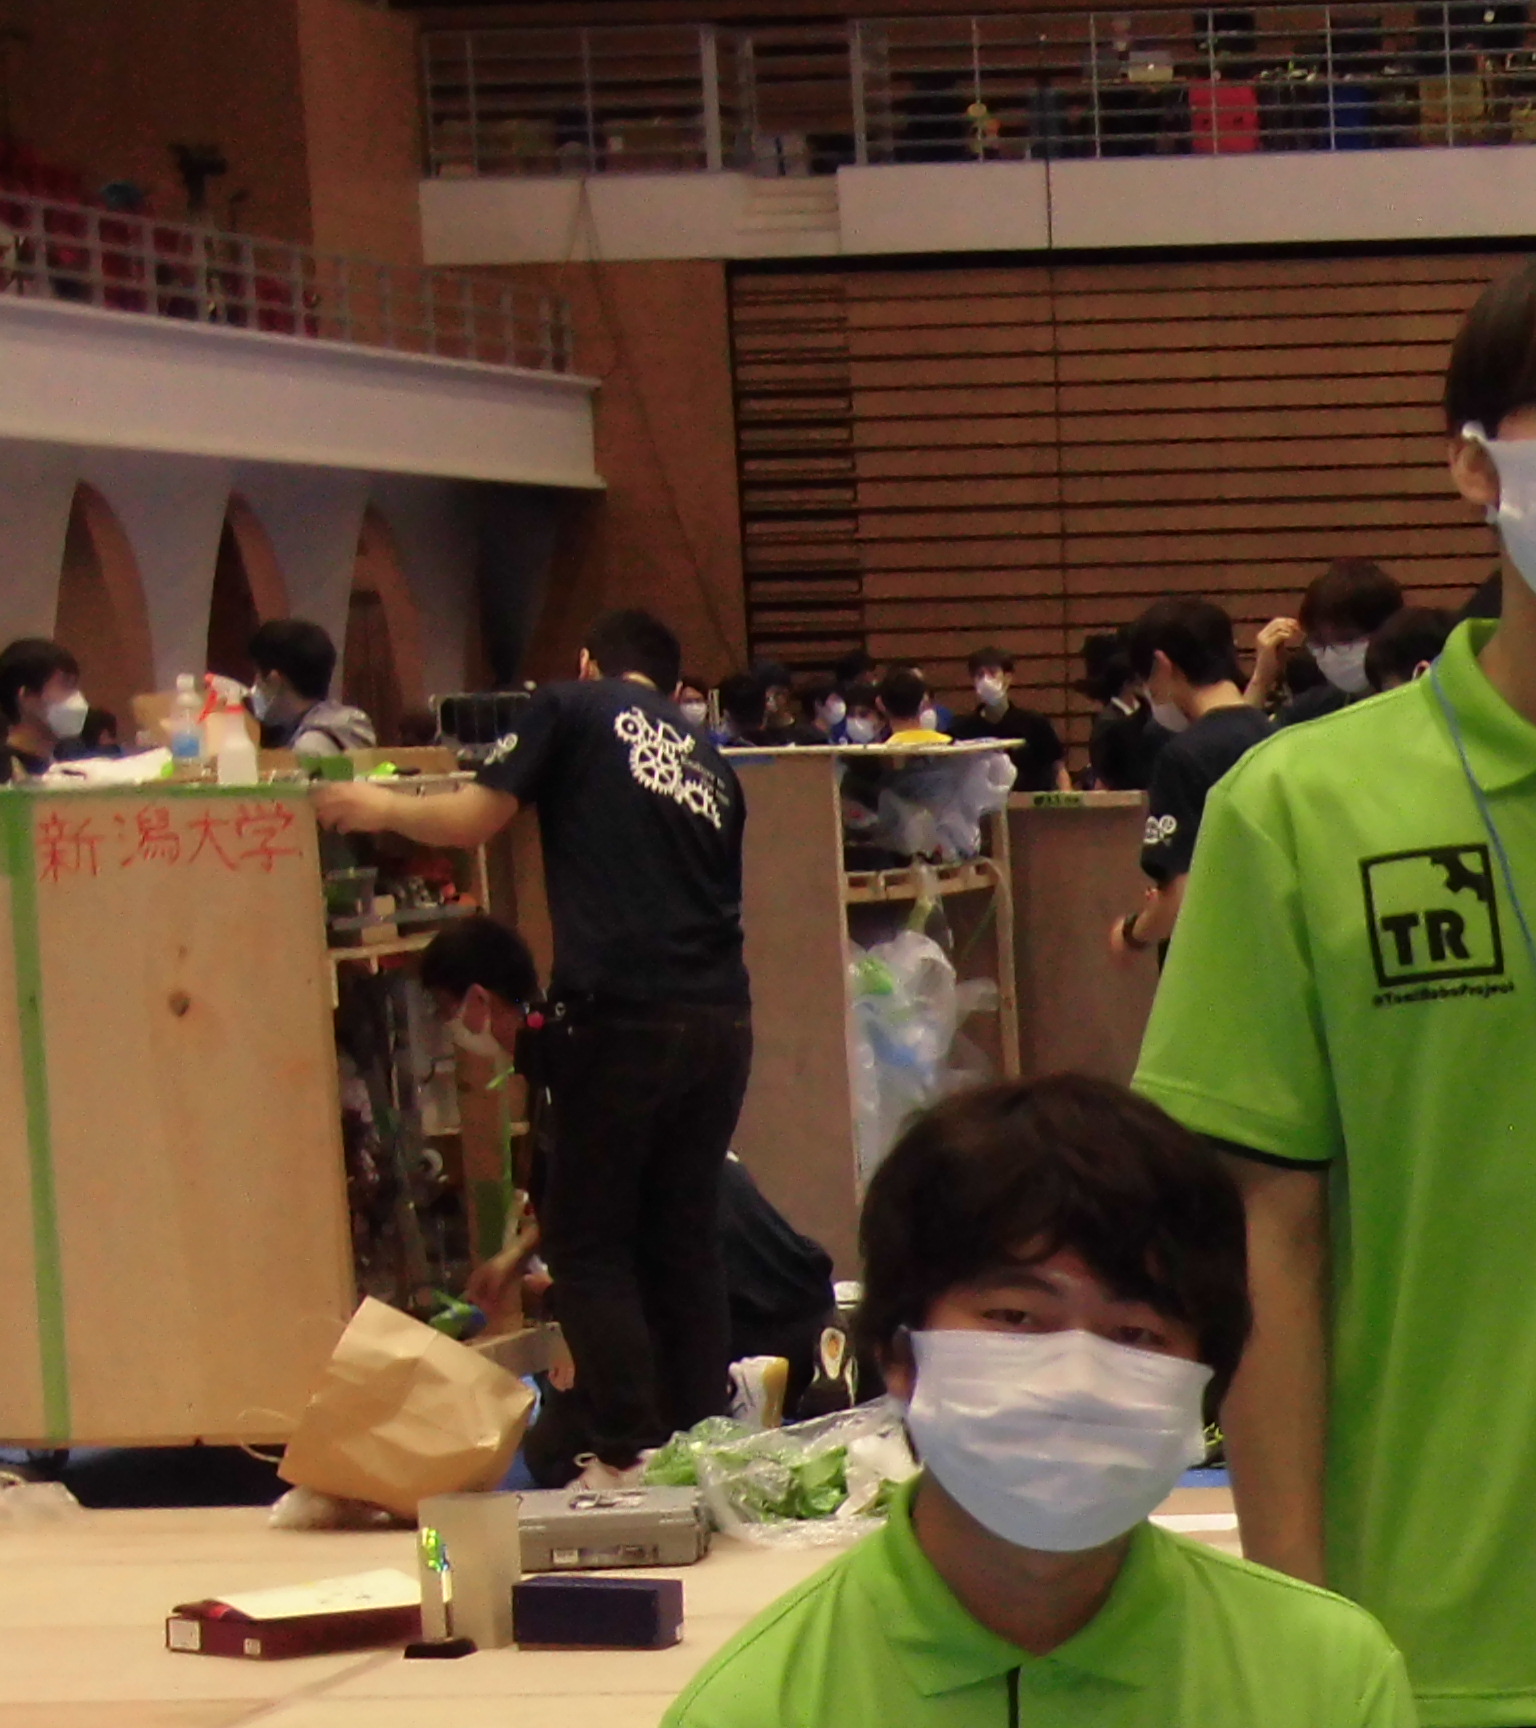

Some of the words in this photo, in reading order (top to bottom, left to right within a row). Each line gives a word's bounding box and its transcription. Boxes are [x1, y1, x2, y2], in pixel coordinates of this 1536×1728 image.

[36, 803, 302, 882] 新潟大学
[1381, 909, 1470, 966] TR
